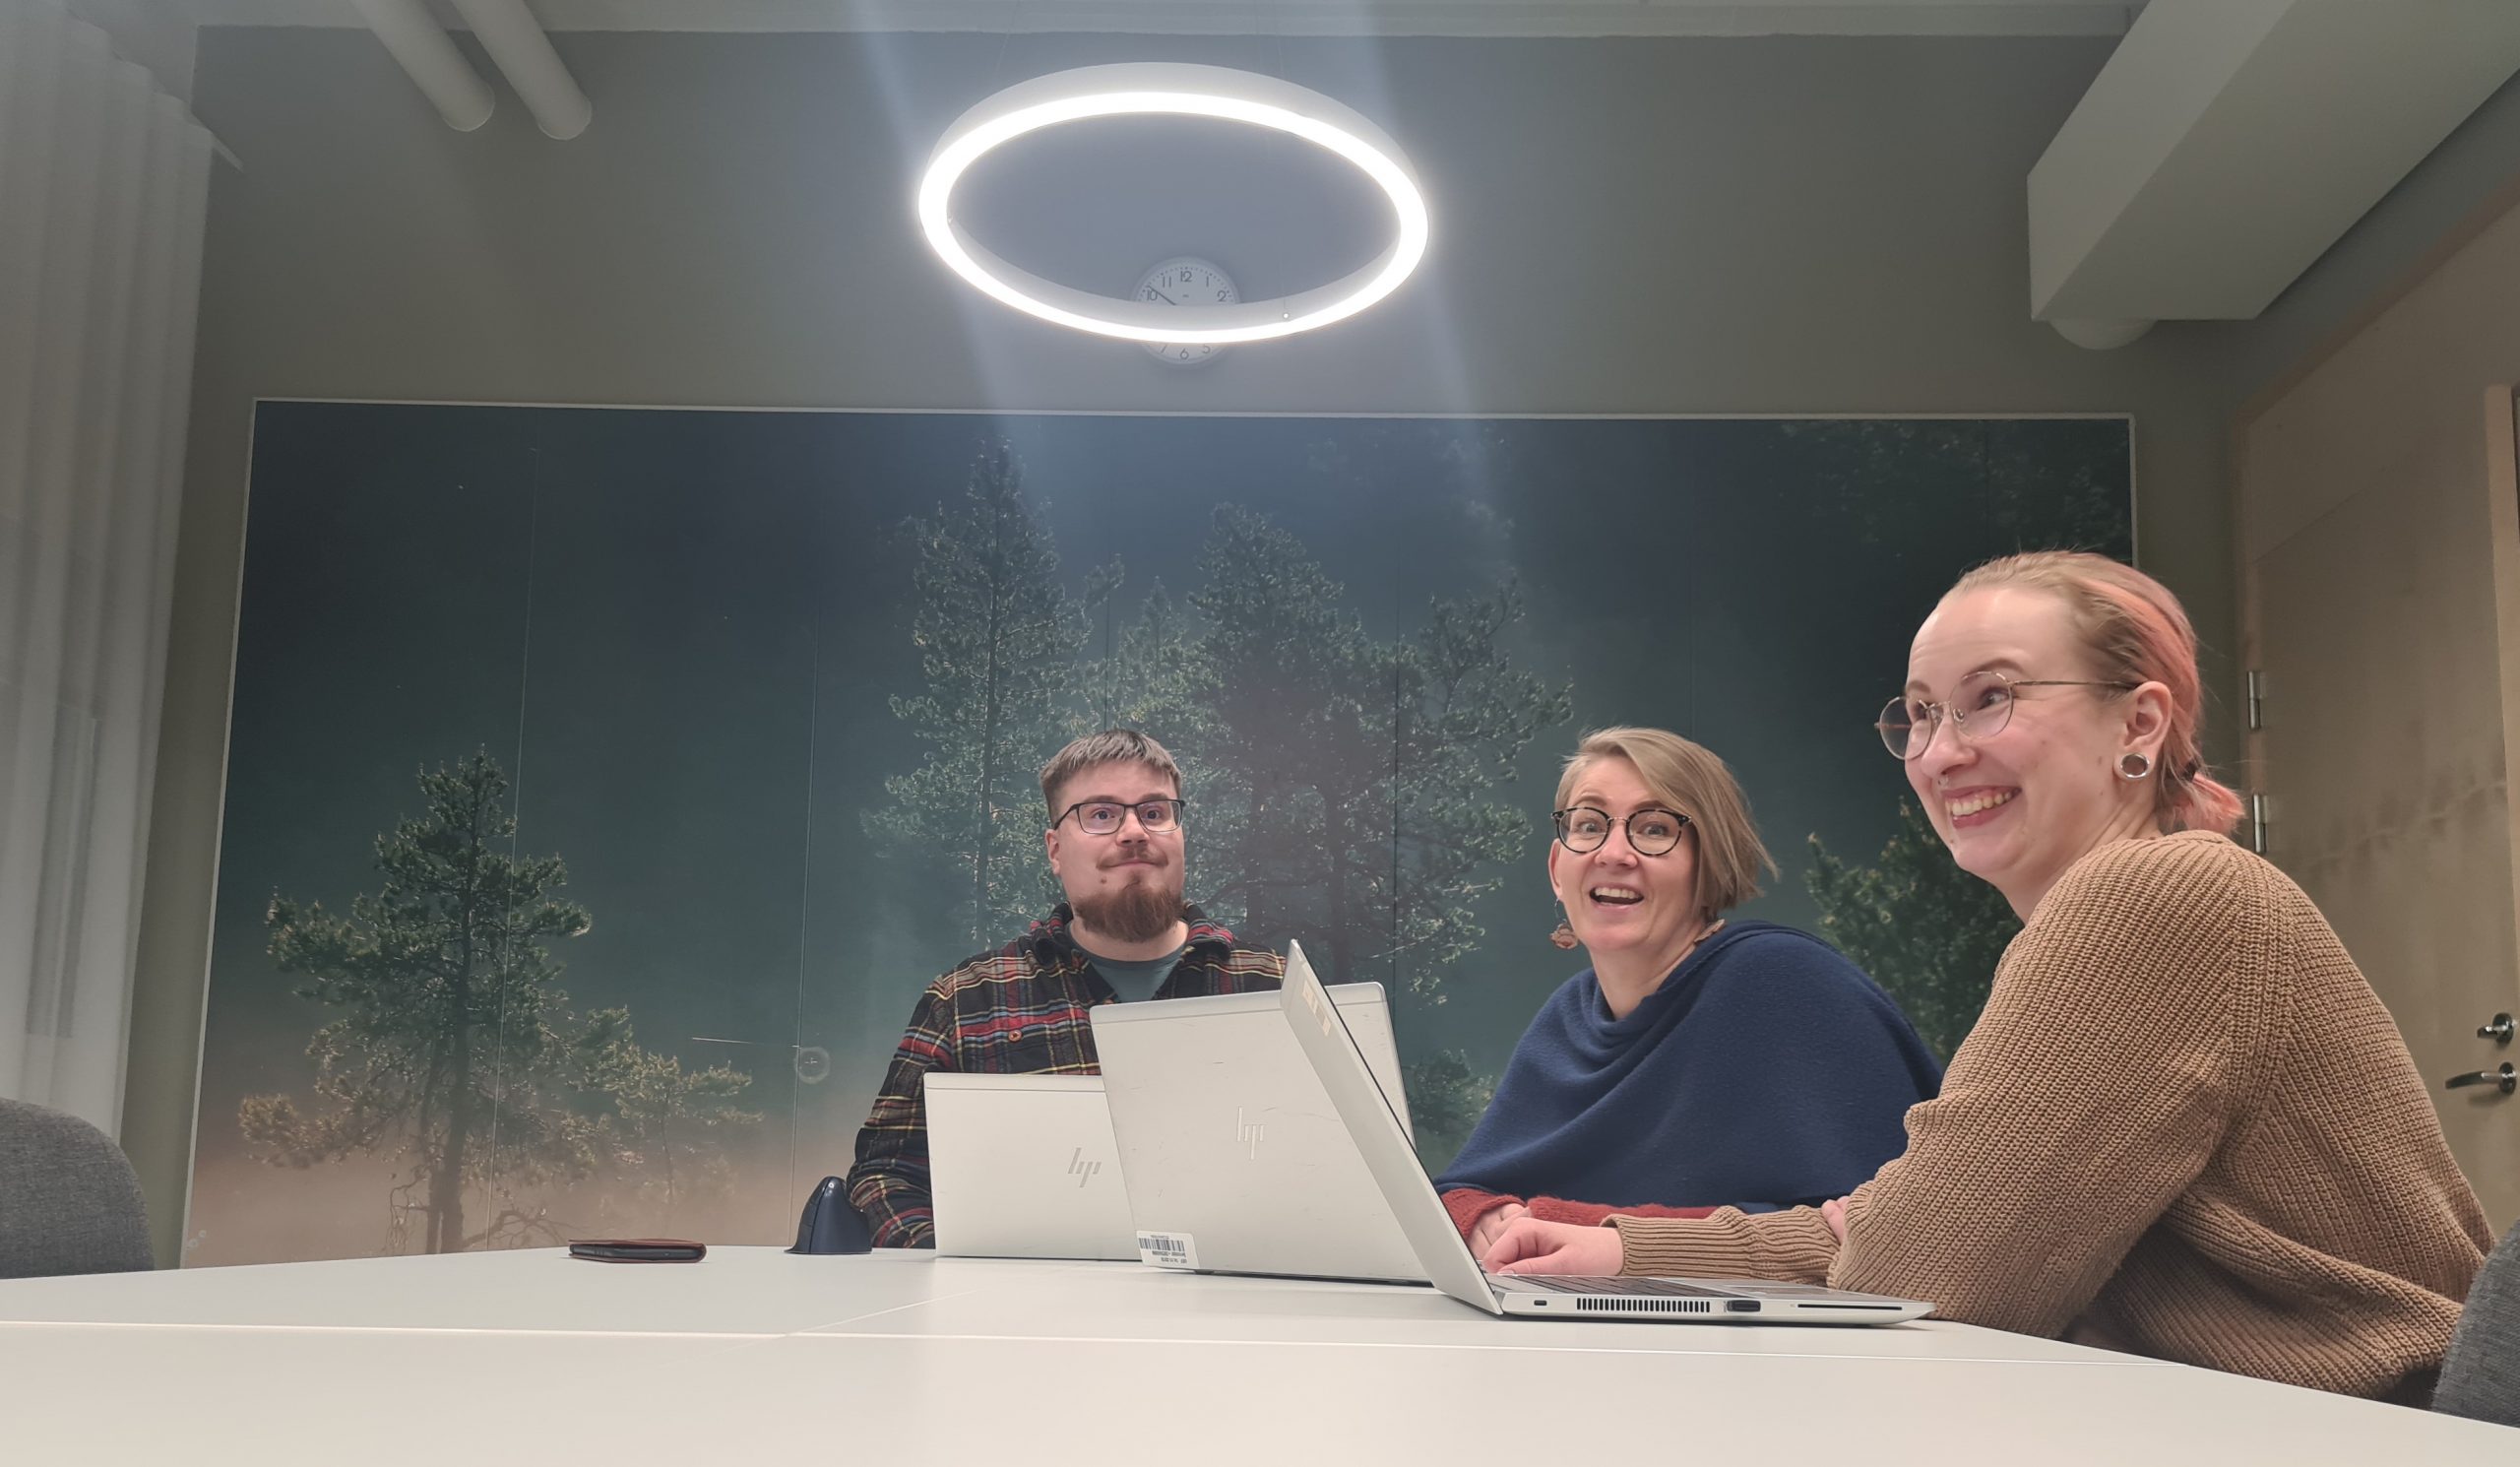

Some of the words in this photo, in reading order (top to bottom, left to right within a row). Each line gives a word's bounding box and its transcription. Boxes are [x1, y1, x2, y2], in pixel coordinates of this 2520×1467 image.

[1163, 276, 1171, 287] 11
[1180, 270, 1192, 283] 12
[1147, 288, 1159, 301] 10
[1217, 289, 1227, 302] 2
[1179, 348, 1189, 360] 6
[1236, 1106, 1264, 1161] hp
[1067, 1147, 1102, 1188] hp
